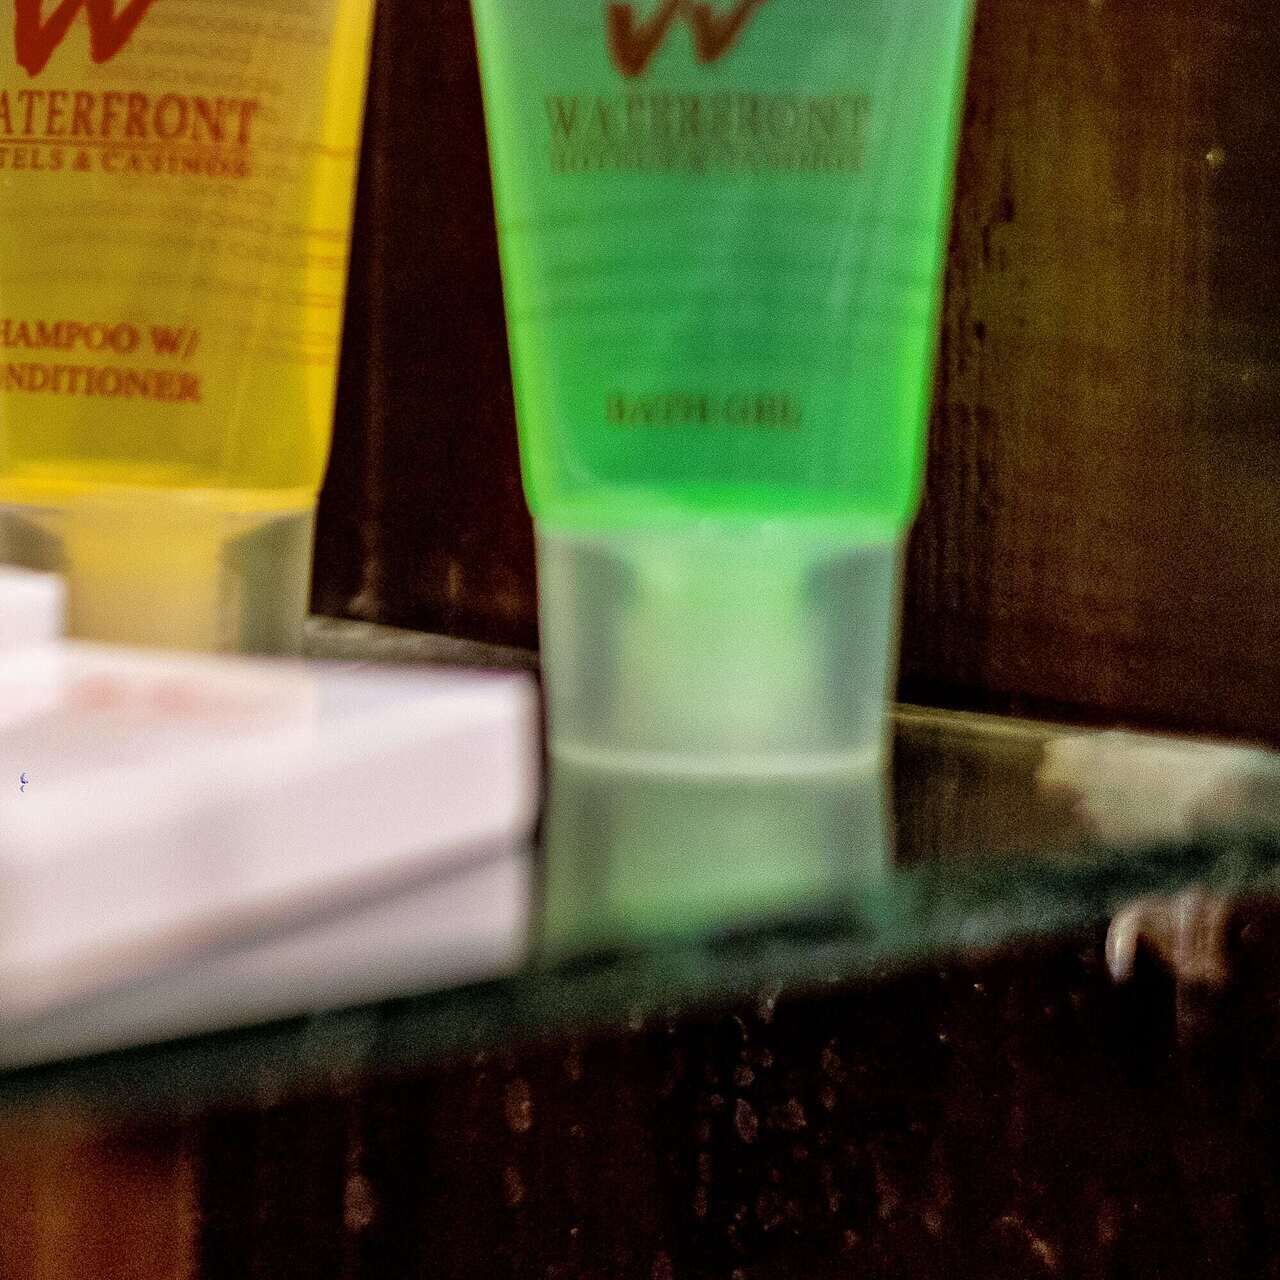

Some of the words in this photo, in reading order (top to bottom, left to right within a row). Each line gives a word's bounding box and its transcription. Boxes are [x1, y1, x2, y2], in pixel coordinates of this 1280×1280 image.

[71, 148, 92, 173] &
[100, 148, 253, 179] CASINOS
[149, 324, 202, 361] W/
